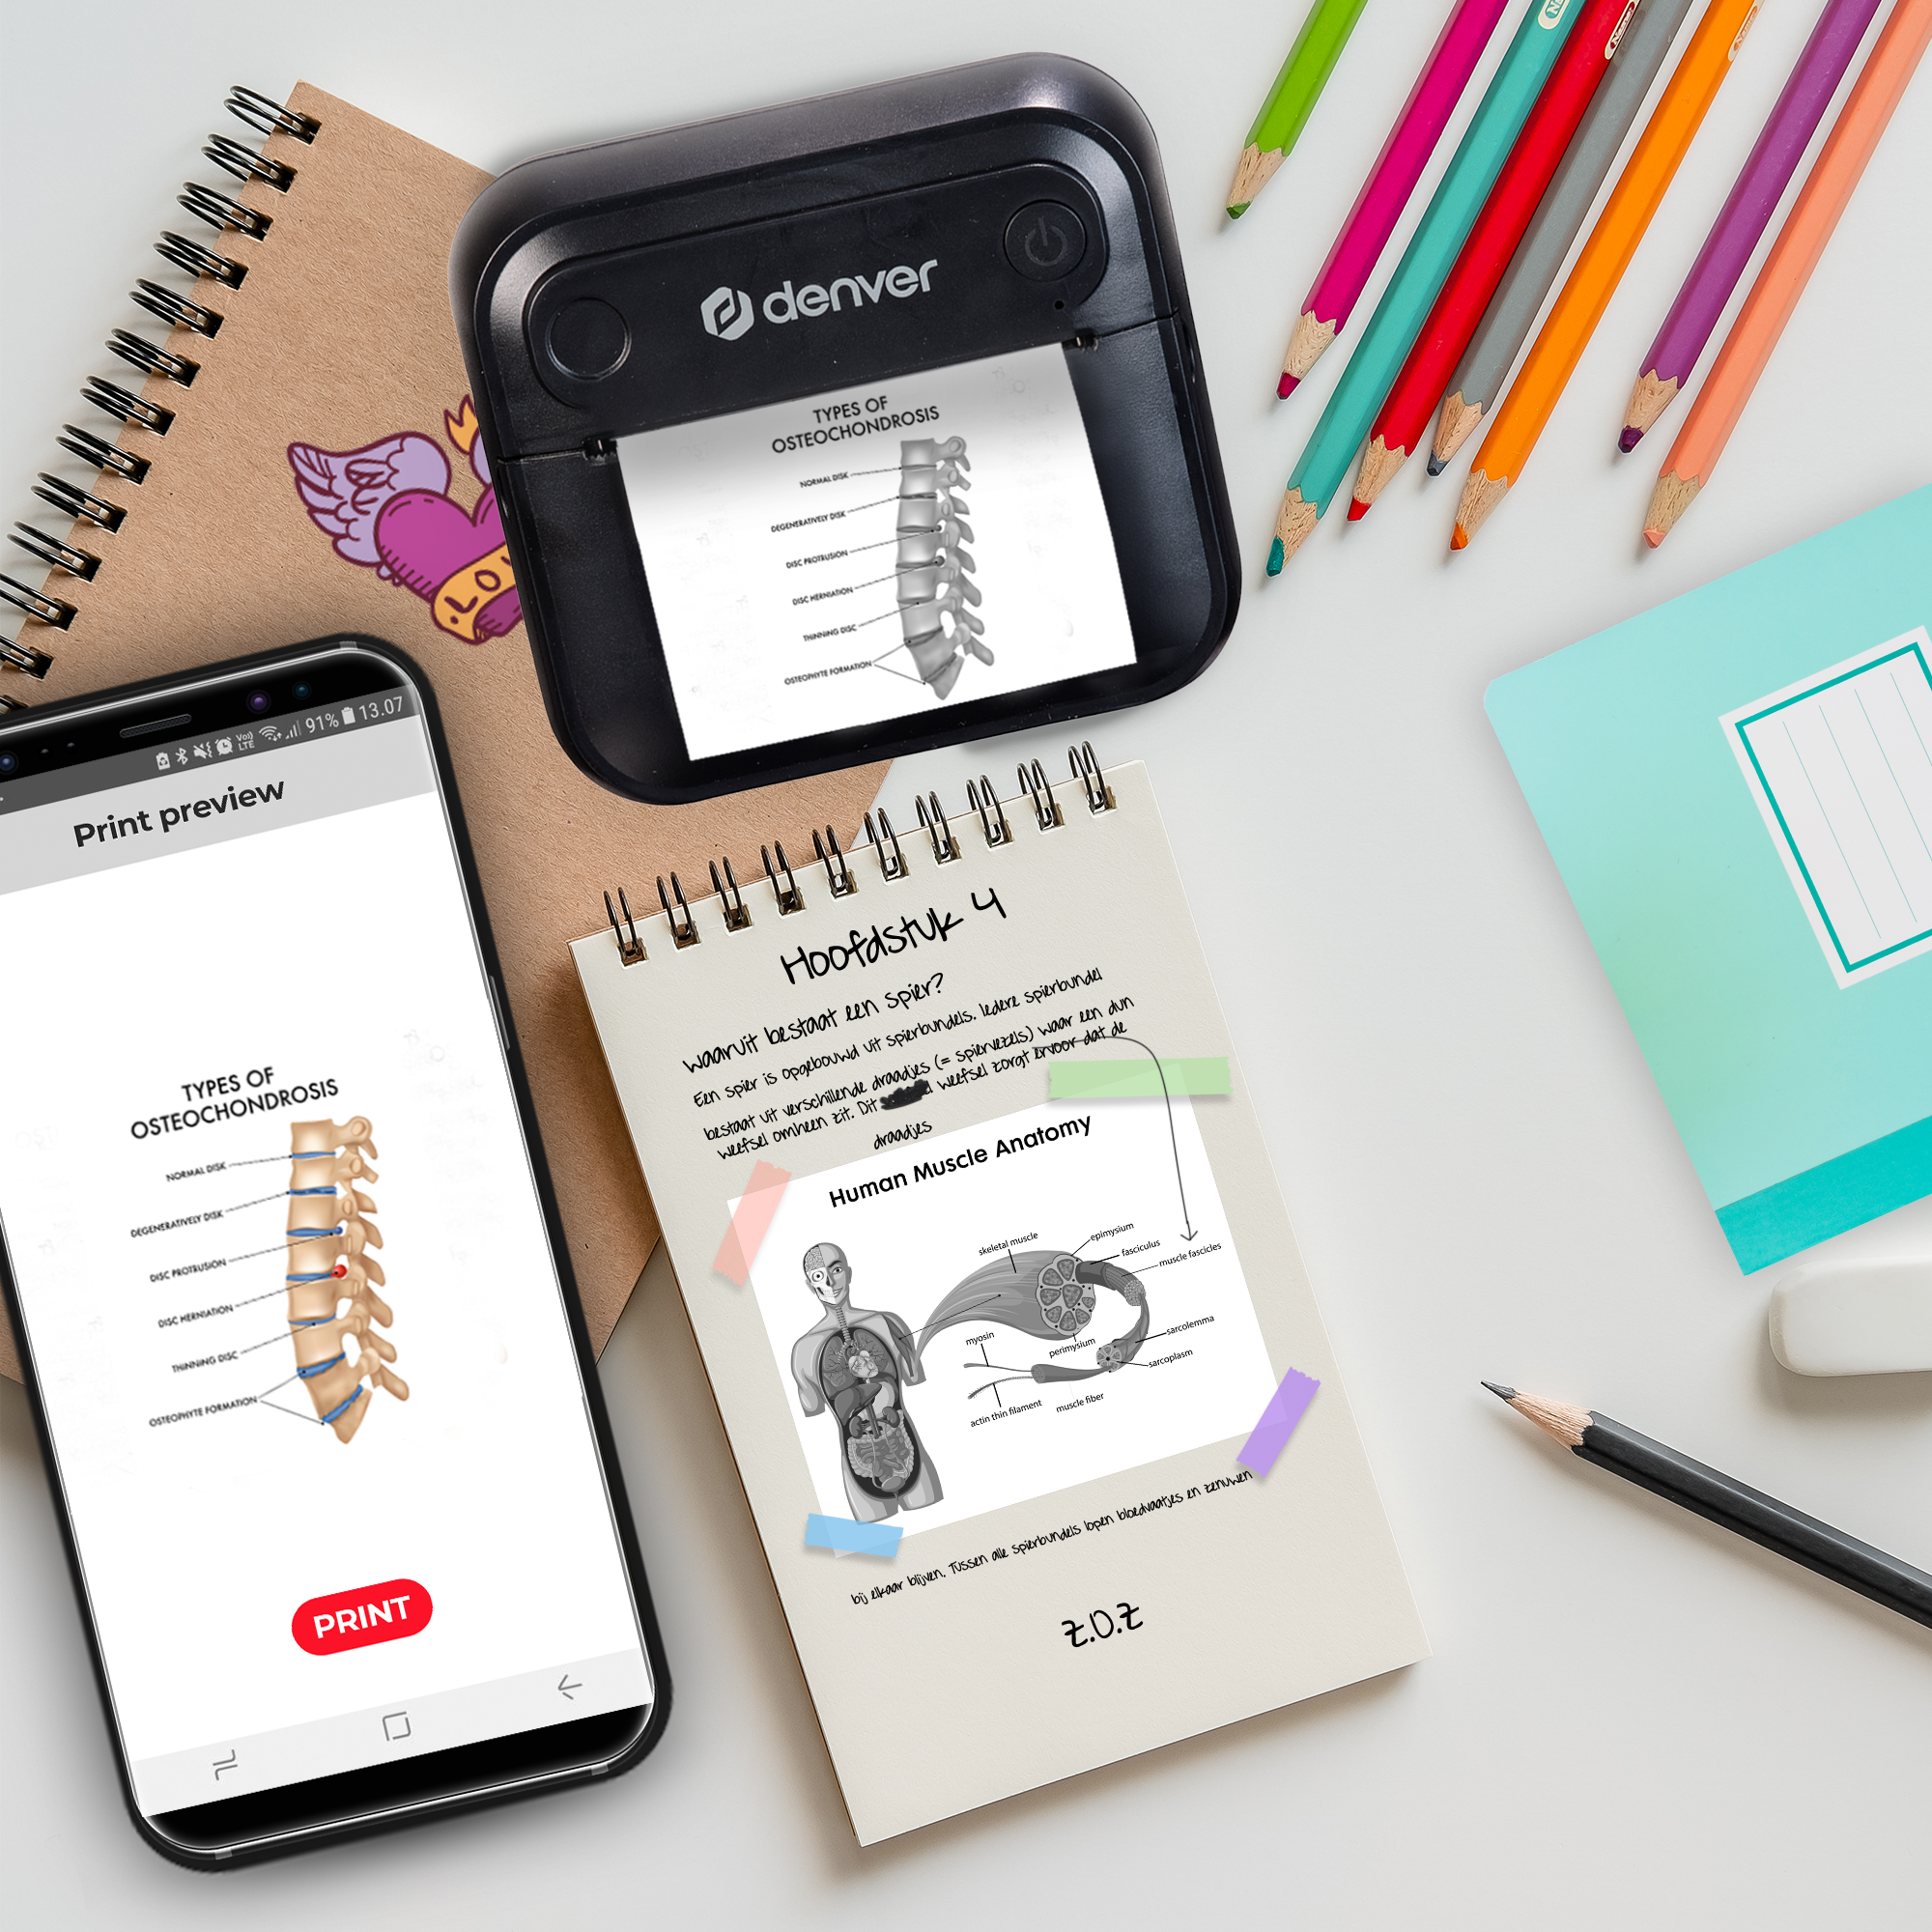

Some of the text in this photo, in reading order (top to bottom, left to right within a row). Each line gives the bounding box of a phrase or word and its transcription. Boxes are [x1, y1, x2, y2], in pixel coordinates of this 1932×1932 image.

[763, 259, 938, 325] denver
[813, 395, 889, 424] TYPES OF
[772, 406, 940, 453] OSTEOCHONDROSIS
[800, 471, 849, 488] NORMAL DISK
[771, 510, 846, 532] DEGENERATIVELY DISK
[785, 550, 848, 569] DISC PROTRUSION
[443, 555, 512, 613] LO
[792, 586, 854, 606] DISC HERNIATION
[803, 624, 858, 641] THINNING DISC
[784, 660, 872, 686] OSTEOPHYTE FORMATION
[358, 696, 405, 722] 13.07
[304, 713, 340, 734] 91%
[238, 739, 255, 751] LTE
[73, 781, 285, 848] Print preview
[780, 887, 1007, 984] Hoofdstuk 4
[764, 1008, 838, 1046] bestaat
[845, 997, 880, 1022] een
[884, 972, 944, 1010] spier?
[694, 1090, 722, 1108] Een
[724, 1078, 758, 1098] spier
[762, 1071, 778, 1086] is
[781, 1044, 860, 1081] opgebouwd
[1024, 967, 1103, 1004] spierbundel
[182, 1065, 275, 1101] TYPES OF
[703, 1114, 756, 1141] bestaat
[782, 1081, 867, 1117] verschillende
[872, 1062, 930, 1091] draadjes
[1037, 1015, 1073, 1037] waar
[1079, 1007, 1103, 1023] een
[717, 1132, 769, 1160] weefsel
[773, 1116, 829, 1143] omheen
[857, 1097, 878, 1115] Dit
[937, 1063, 988, 1091] weefsel
[991, 1049, 1030, 1072] zorgt
[1034, 1037, 1077, 1061] ervoor
[1083, 1026, 1106, 1046] dat
[1111, 1021, 1128, 1037] de
[130, 1078, 339, 1139] OSTEOCHONDROSIS
[873, 1121, 932, 1151] draadjes
[165, 1161, 227, 1182] NORMAL DISK
[829, 1115, 1092, 1208] Human Muscle Anatomy
[130, 1209, 224, 1238] DEGENERATIVELY DISK
[1090, 1222, 1134, 1241] epimysium
[978, 1232, 1038, 1256] skeletal muscle
[1122, 1239, 1161, 1257] fasciculus
[1158, 1242, 1222, 1267] muscle fascicles
[150, 1259, 227, 1283] DISC PROTRUSION
[157, 1304, 234, 1328] DISC HERNIATION
[1166, 1315, 1215, 1335] sarcolemma
[965, 1330, 995, 1346] myosin
[1049, 1337, 1096, 1359] perimysium
[171, 1350, 239, 1374] THINNING DISC
[1148, 1349, 1194, 1369] sarcoplasm
[149, 1396, 258, 1427] OSTEOPHYTE FORMATION
[970, 1399, 1042, 1428] actin thin filament
[1056, 1392, 1104, 1413] muscle fiber
[850, 1592, 868, 1605] bij
[870, 1580, 903, 1600] elkaar
[948, 1553, 988, 1575] Tussen
[991, 1548, 1009, 1561] alle
[1011, 1524, 1081, 1557] spierbundels
[1083, 1513, 1114, 1532] lopen
[1116, 1492, 1183, 1520] bloedvaatjes
[1186, 1487, 1201, 1499] en
[312, 1595, 412, 1639] PRINT
